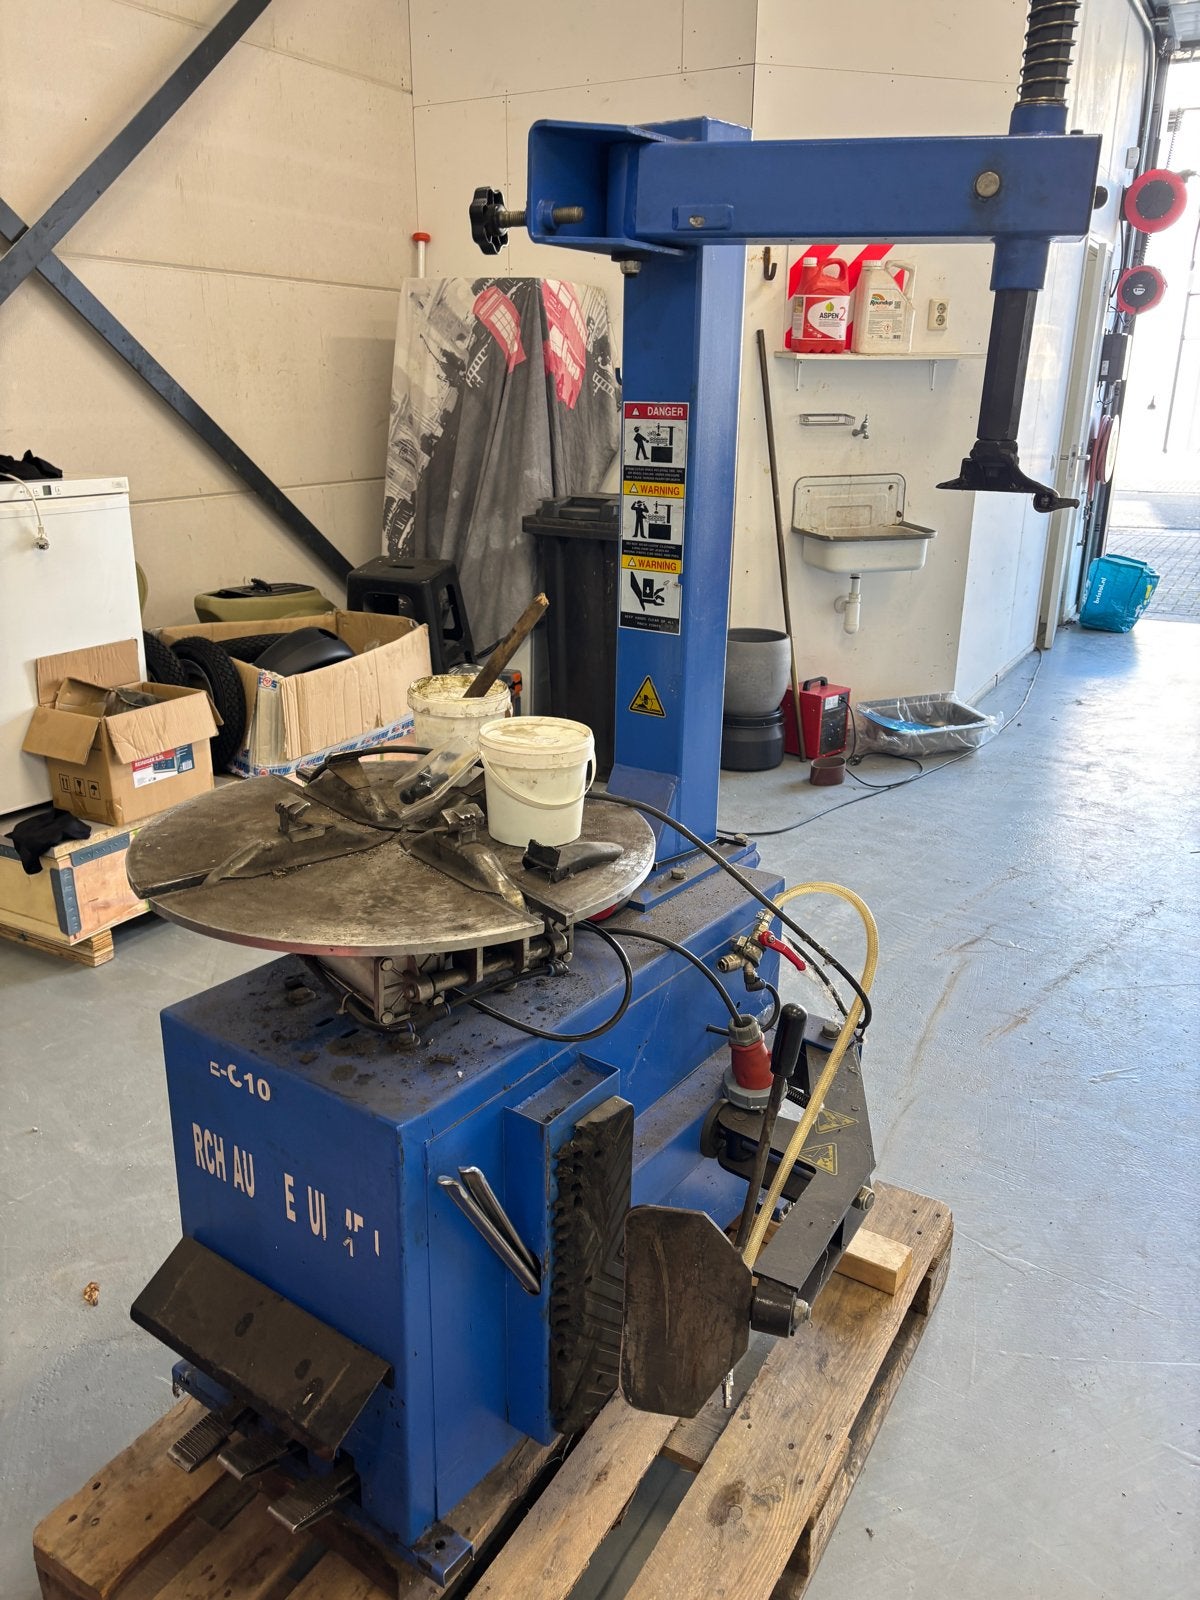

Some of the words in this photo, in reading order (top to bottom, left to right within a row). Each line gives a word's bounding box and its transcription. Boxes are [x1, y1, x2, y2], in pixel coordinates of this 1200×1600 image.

[869, 299, 893, 307] Roundup
[839, 307, 846, 322] 2
[647, 406, 684, 417] DANGER
[640, 484, 680, 496] WARNING
[638, 559, 677, 571] WARNING
[1093, 577, 1107, 605] bristol.nl
